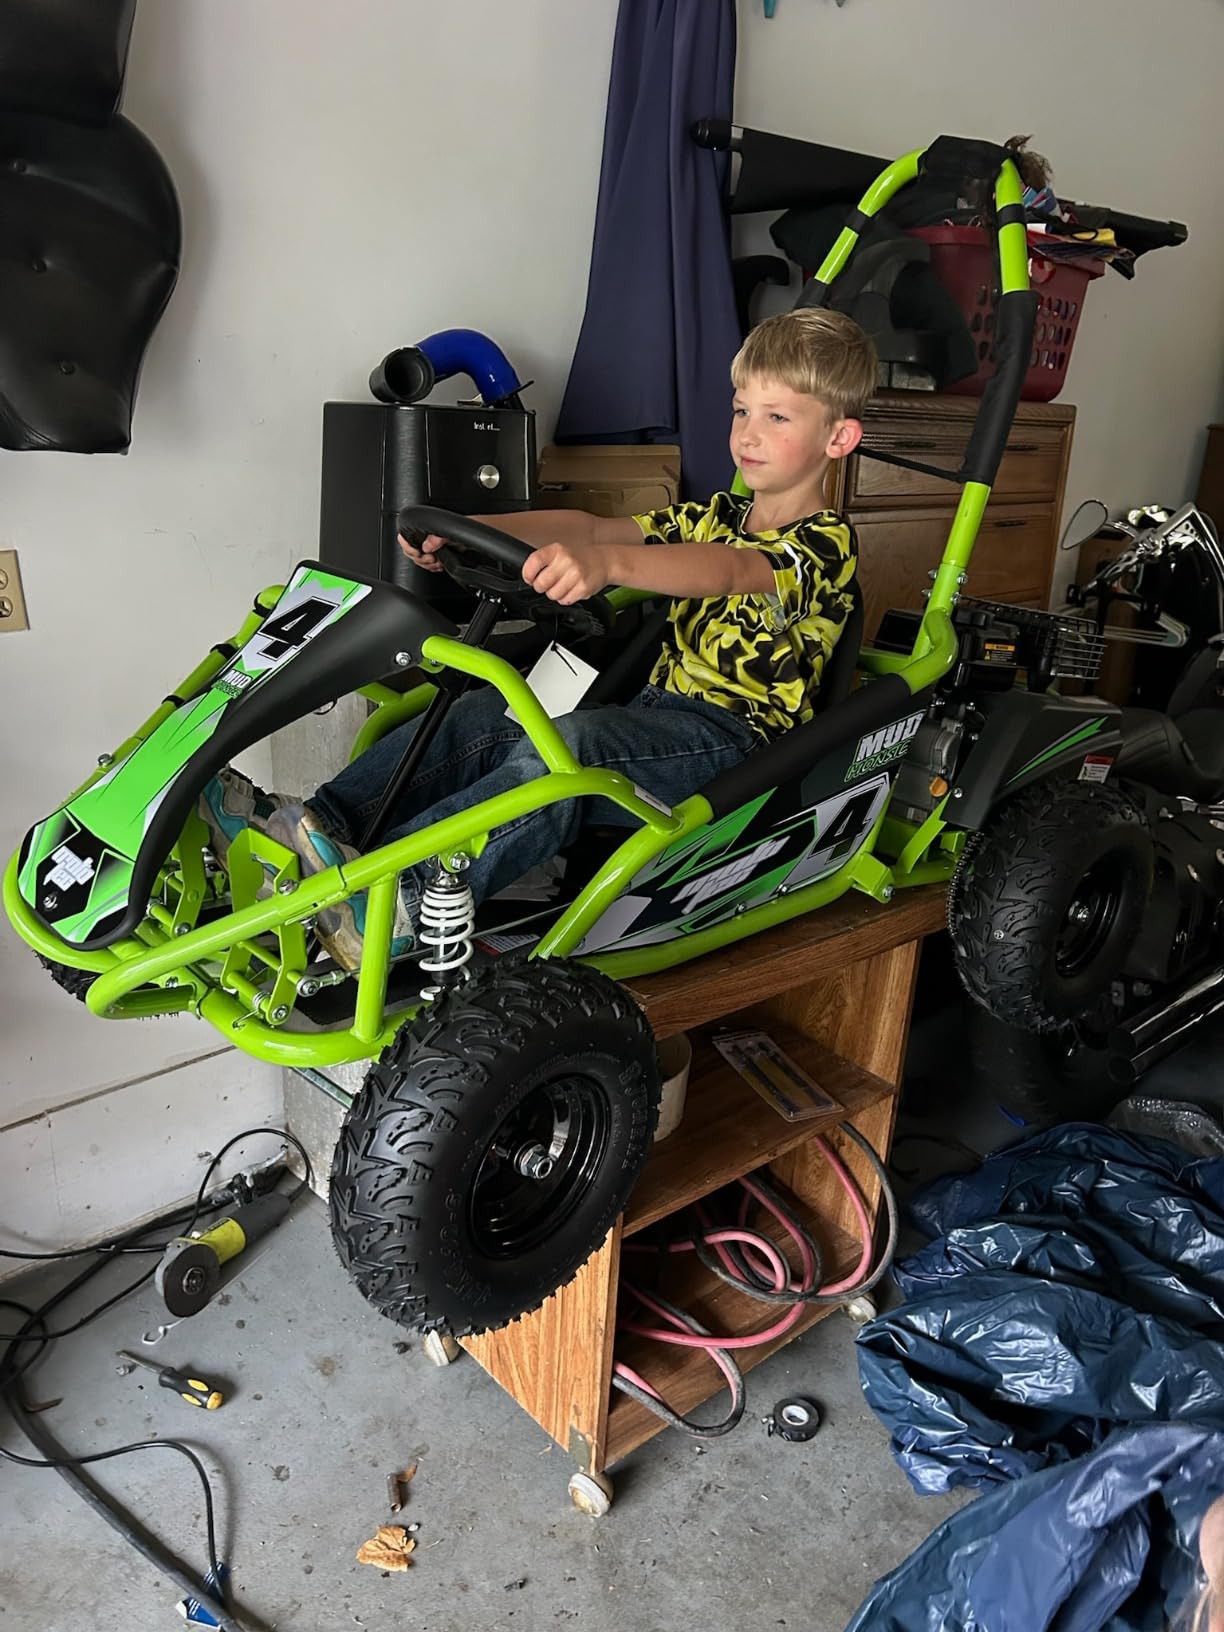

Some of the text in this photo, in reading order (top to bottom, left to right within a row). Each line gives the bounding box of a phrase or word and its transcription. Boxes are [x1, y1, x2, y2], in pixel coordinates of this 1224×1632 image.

[257, 596, 340, 662] 4
[220, 670, 253, 688] MUD
[845, 736, 914, 782] MONSTE
[857, 713, 924, 762] MUD
[807, 783, 886, 865] 4
